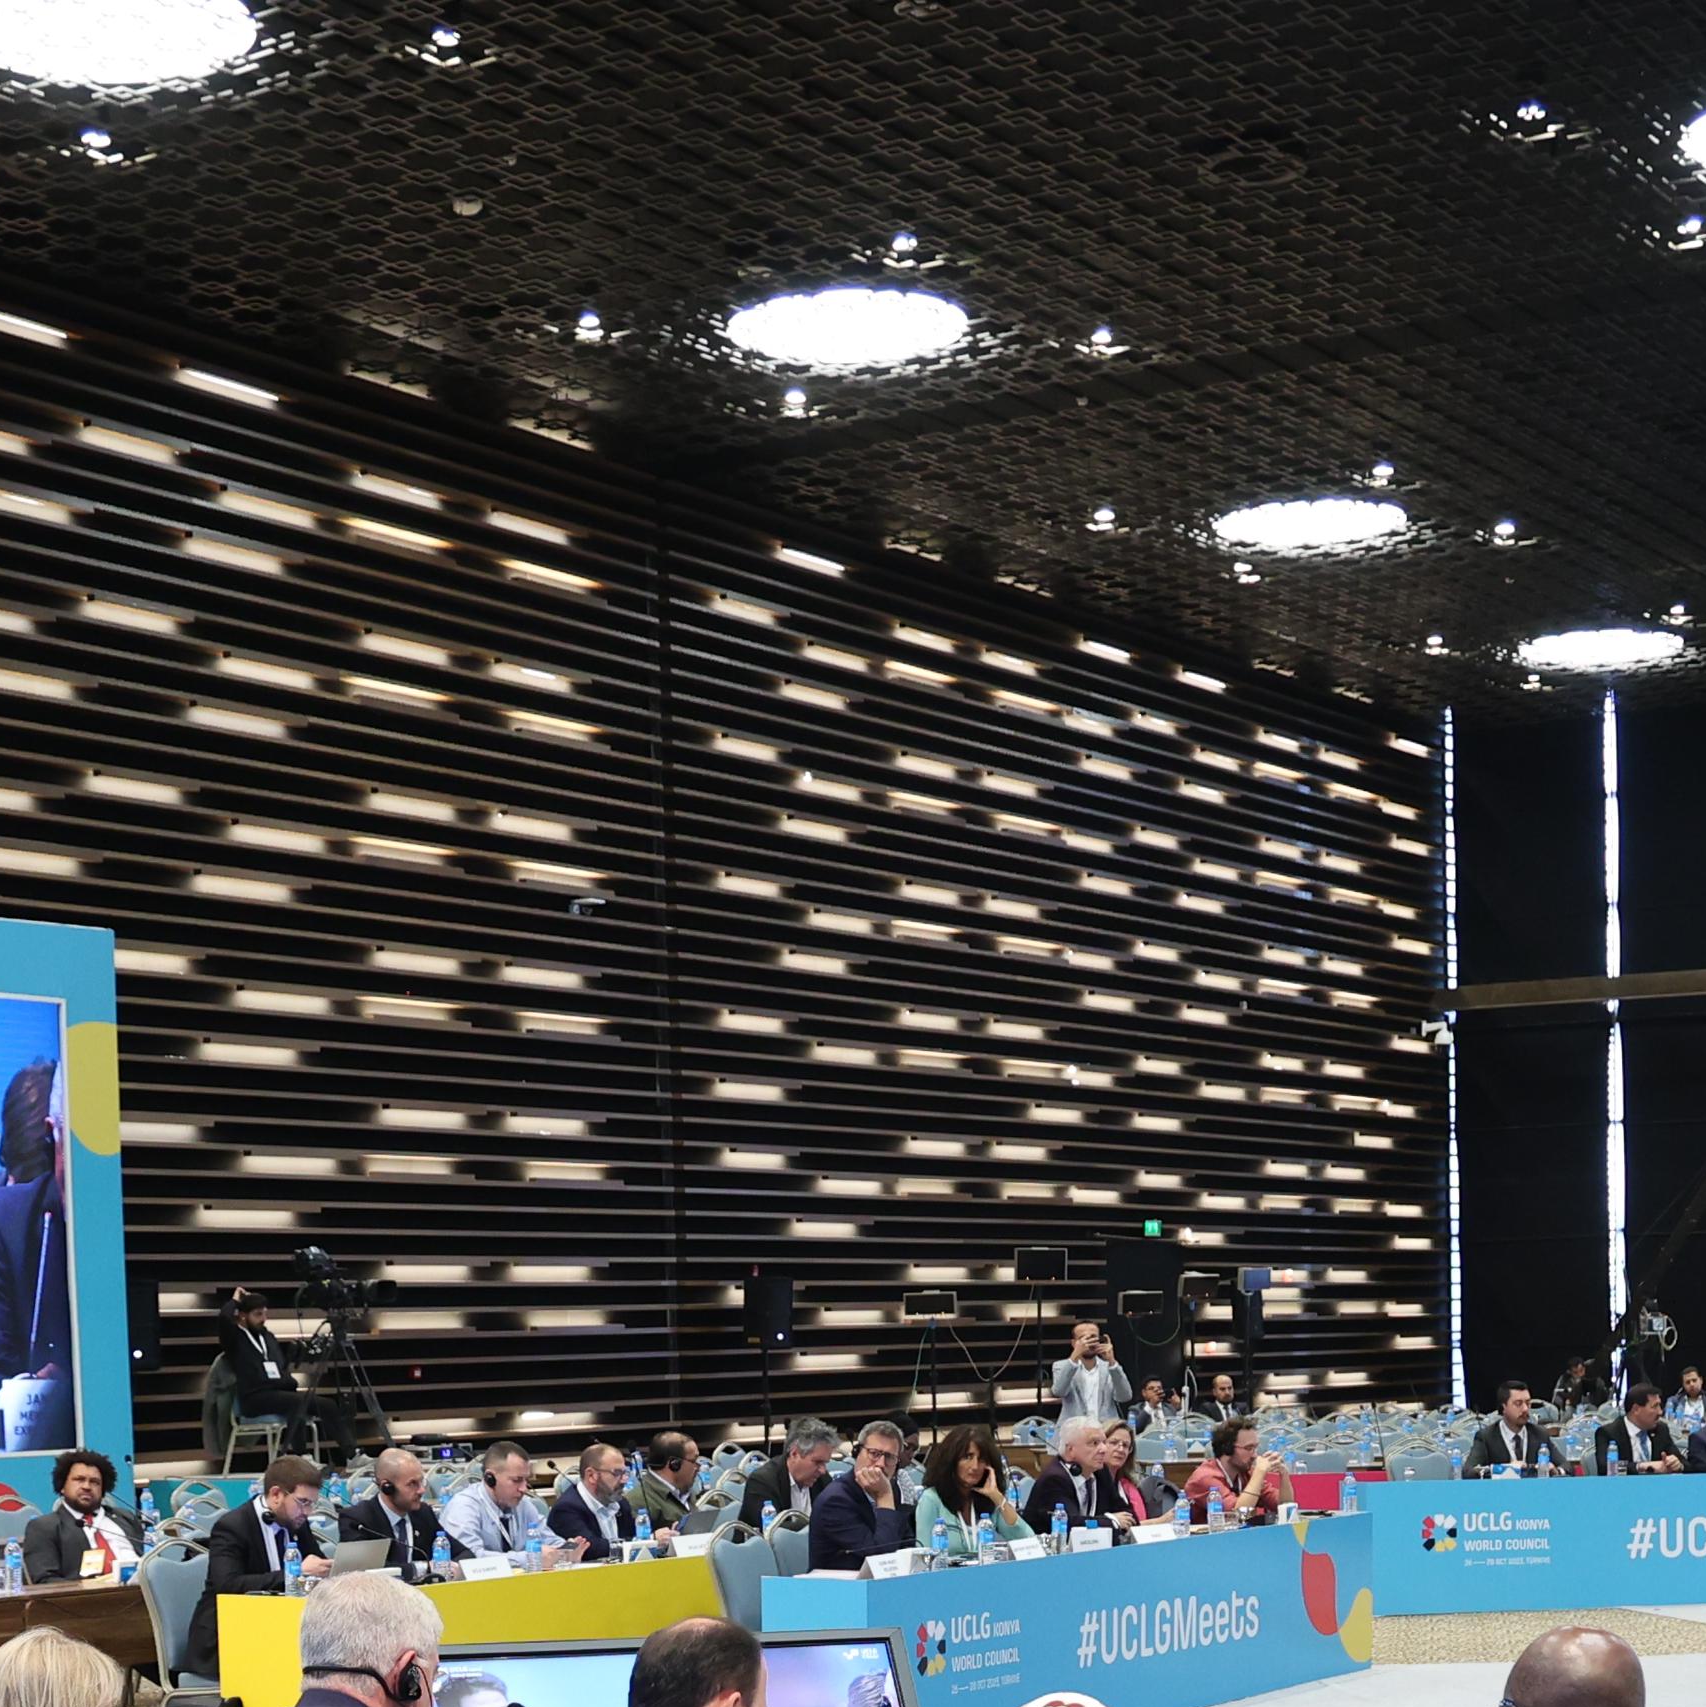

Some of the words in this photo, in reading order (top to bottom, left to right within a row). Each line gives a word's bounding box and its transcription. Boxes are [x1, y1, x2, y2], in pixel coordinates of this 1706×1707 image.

[1463, 1511, 1513, 1533] UCLG
[1515, 1518, 1551, 1531] KONYA
[1464, 1539, 1503, 1552] WORLD
[1505, 1537, 1551, 1551] COUNCIL
[950, 1611, 991, 1644] UCLG
[993, 1619, 1021, 1638] KONYA
[1077, 1590, 1260, 1669] #UCLGMeets
[951, 1651, 983, 1673] WORLD
[984, 1647, 1021, 1668] COUNCIL
